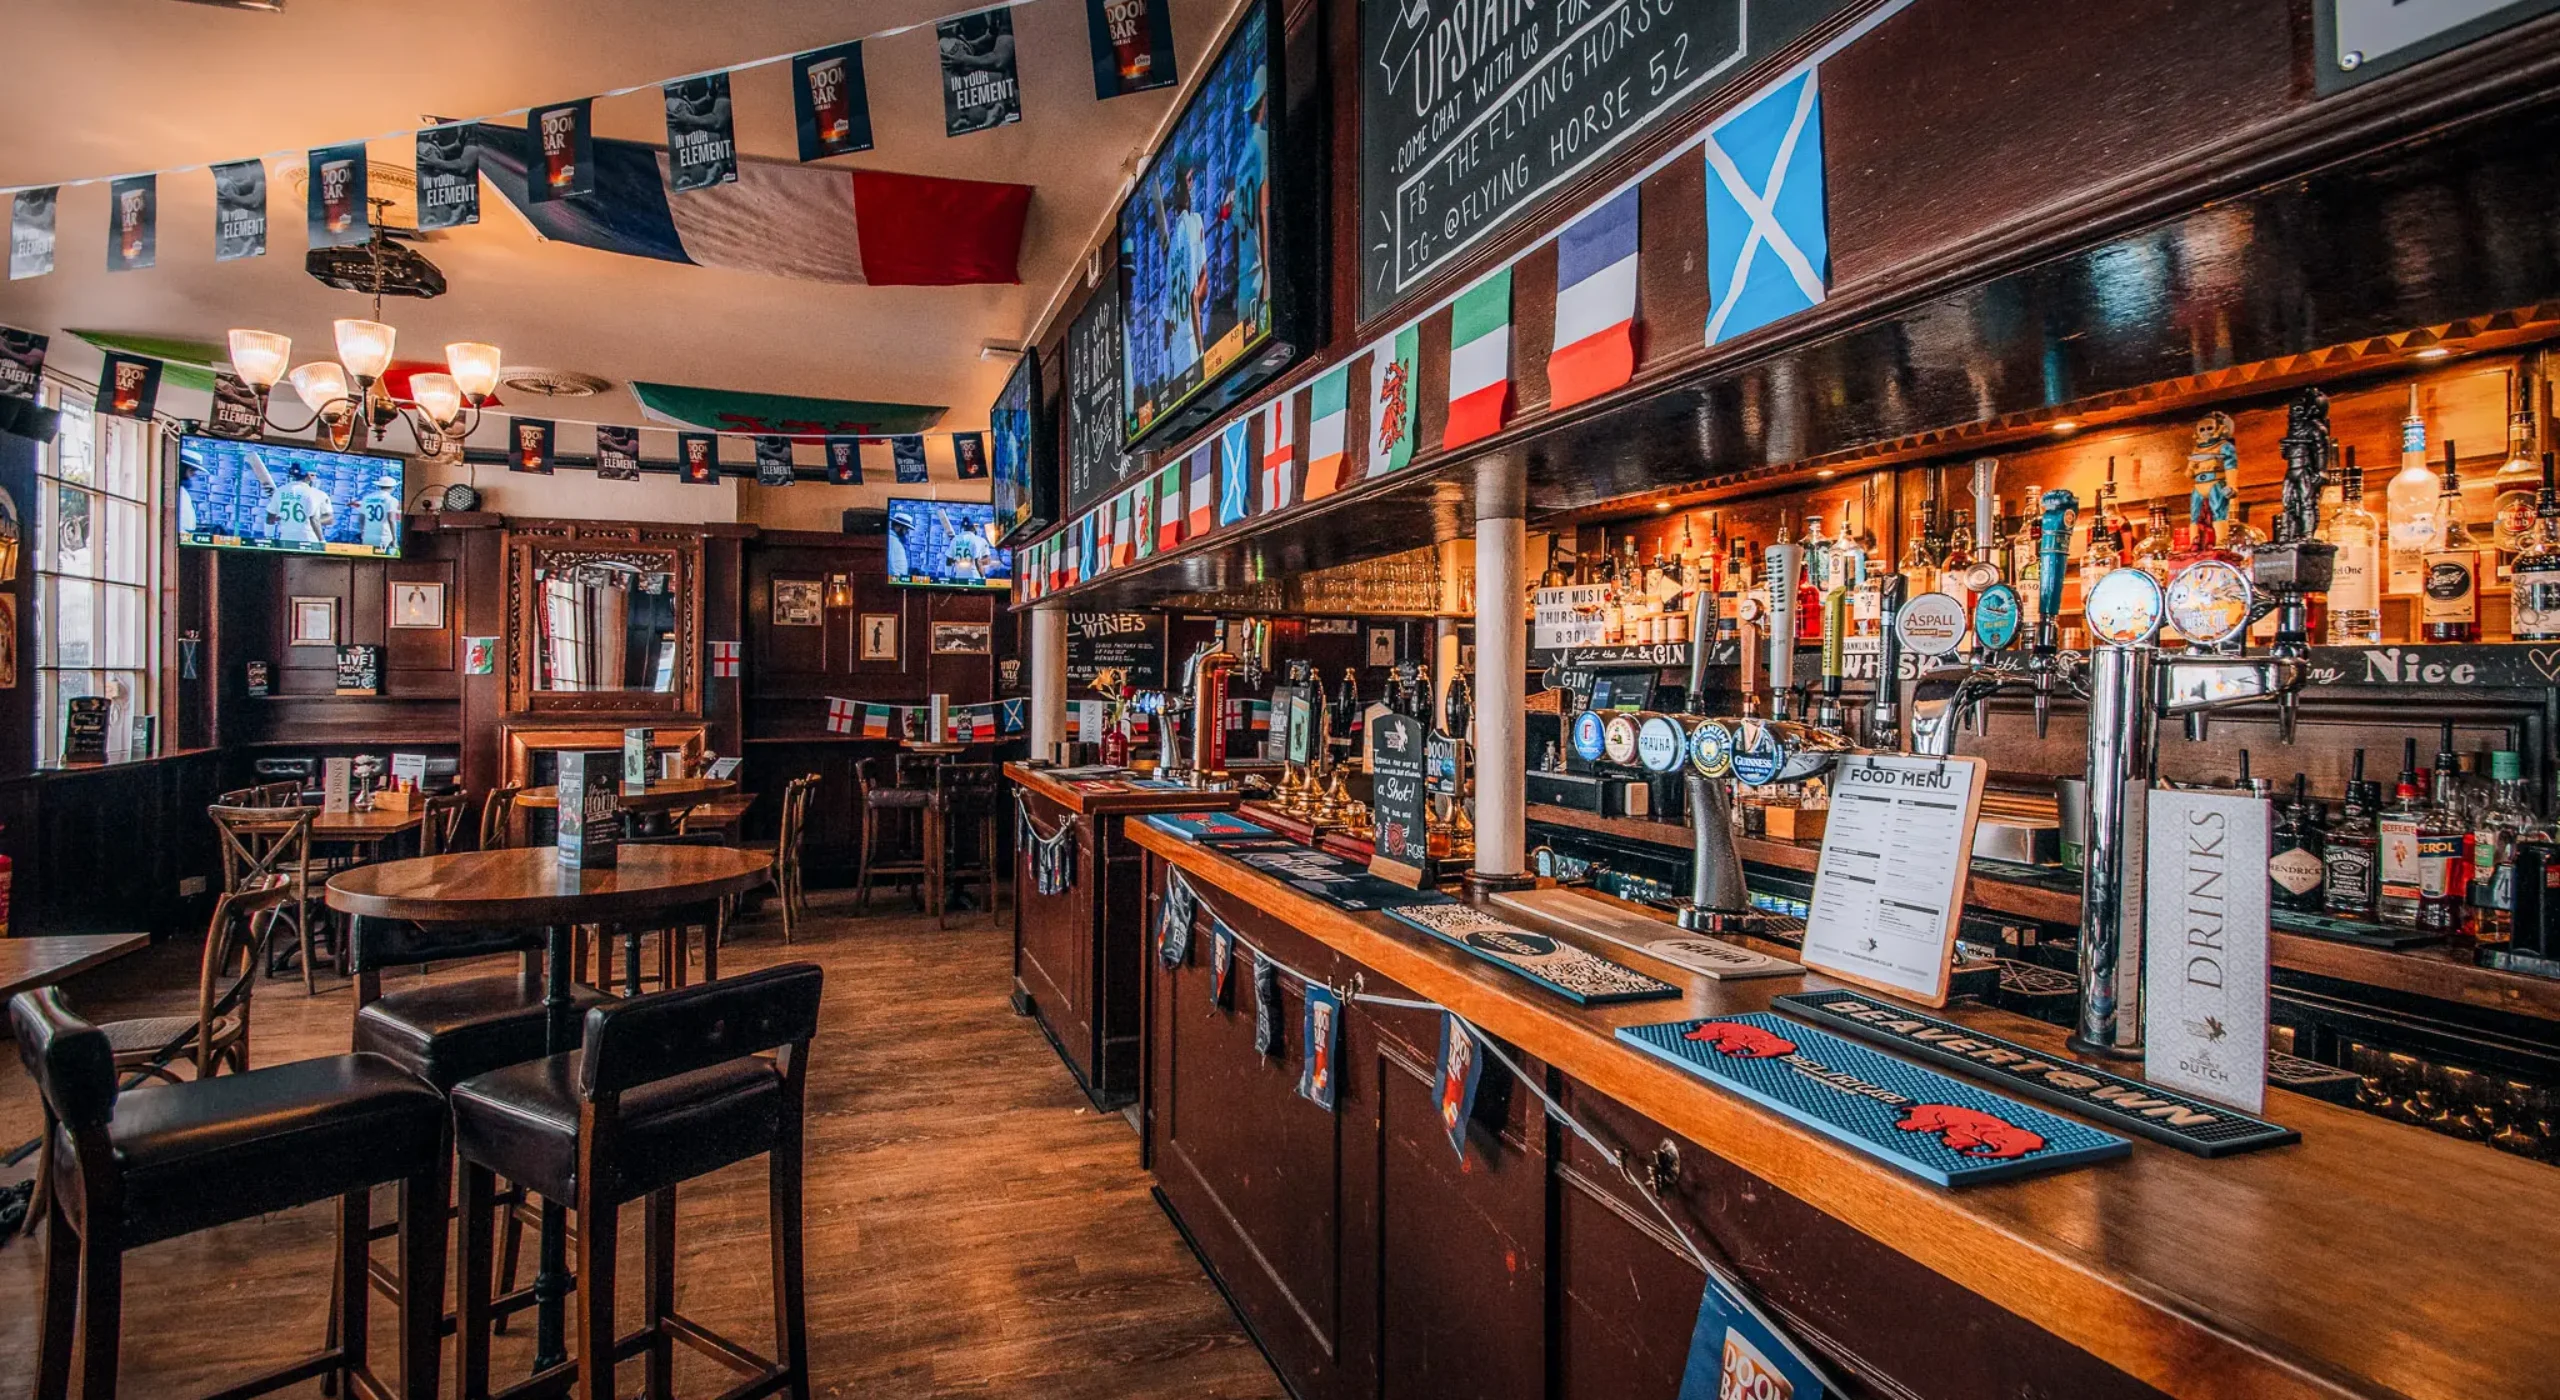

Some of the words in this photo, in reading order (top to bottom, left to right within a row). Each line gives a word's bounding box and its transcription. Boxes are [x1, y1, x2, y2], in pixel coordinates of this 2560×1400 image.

[1109, 19, 1138, 40] BAR
[1414, 0, 1536, 117] UPSTA
[951, 76, 962, 92] IN
[963, 70, 989, 88] YOUR
[812, 85, 838, 106] BAR
[956, 79, 1014, 110] ELEMENT
[1398, 124, 1428, 174] COME
[1432, 90, 1463, 142] CHAT
[1473, 44, 1514, 104] WITH
[1521, 22, 1539, 60] US
[1445, 132, 1480, 186] THE
[1488, 53, 1574, 150] FLYING
[543, 132, 566, 149] BAR
[675, 134, 685, 149] IN
[685, 131, 709, 147] YOUR
[1444, 153, 1530, 240] @FLYING
[1550, 77, 1631, 167] HORSE
[1649, 33, 1691, 96] 52
[679, 140, 731, 168] ELEMENT
[423, 176, 432, 191] IN
[433, 174, 456, 189] YOUR
[426, 184, 476, 207] ELEMENT
[224, 218, 265, 239] ELEMENT
[0, 368, 35, 386] EMENT
[219, 409, 262, 427] ELEMENT
[604, 458, 637, 470] ELEMENT
[762, 464, 791, 475] ELEMENT
[900, 464, 927, 474] ELEMENT
[279, 501, 306, 523] 56
[365, 504, 384, 522] 30
[955, 547, 972, 559] 56
[2344, 565, 2362, 575] One
[1536, 591, 1565, 605] LIVE
[1571, 589, 1611, 602] MUSIC
[1081, 617, 1146, 638] WINES
[1539, 610, 1604, 626] THURSYS
[1904, 612, 1956, 631] ASPALL
[1843, 641, 1870, 651] RANKLIN
[1871, 641, 1876, 651] &
[337, 653, 374, 668] LIVE!
[338, 665, 362, 674] MUSIC
[1076, 665, 1092, 673] OUR
[1842, 654, 1939, 680] WHSK
[1992, 654, 2024, 671] ith
[2306, 661, 2345, 685] ing
[2363, 648, 2475, 685] Nice
[1216, 683, 1224, 719] MORETTI
[1584, 724, 1592, 740] F
[1640, 736, 1671, 752] PRAVHA
[1734, 755, 1772, 768] GUINNESS
[333, 760, 343, 794] DRINKS
[1851, 768, 1896, 784] FOOD
[1901, 771, 1952, 790] MENU
[1378, 783, 1385, 796] a
[1386, 776, 1416, 803] Shot!
[584, 794, 619, 815] HOUR
[2382, 823, 2417, 835] BEEFEATE
[2417, 842, 2455, 854] PEROL
[2269, 863, 2323, 876] HENDRICK
[2186, 809, 2226, 990] DRINKS
[1822, 999, 2218, 1127] BEAVERTOWN
[2180, 1061, 2230, 1082] DUTCH
[1724, 1340, 1789, 1400] DOO
[1719, 1371, 1757, 1400] BA
